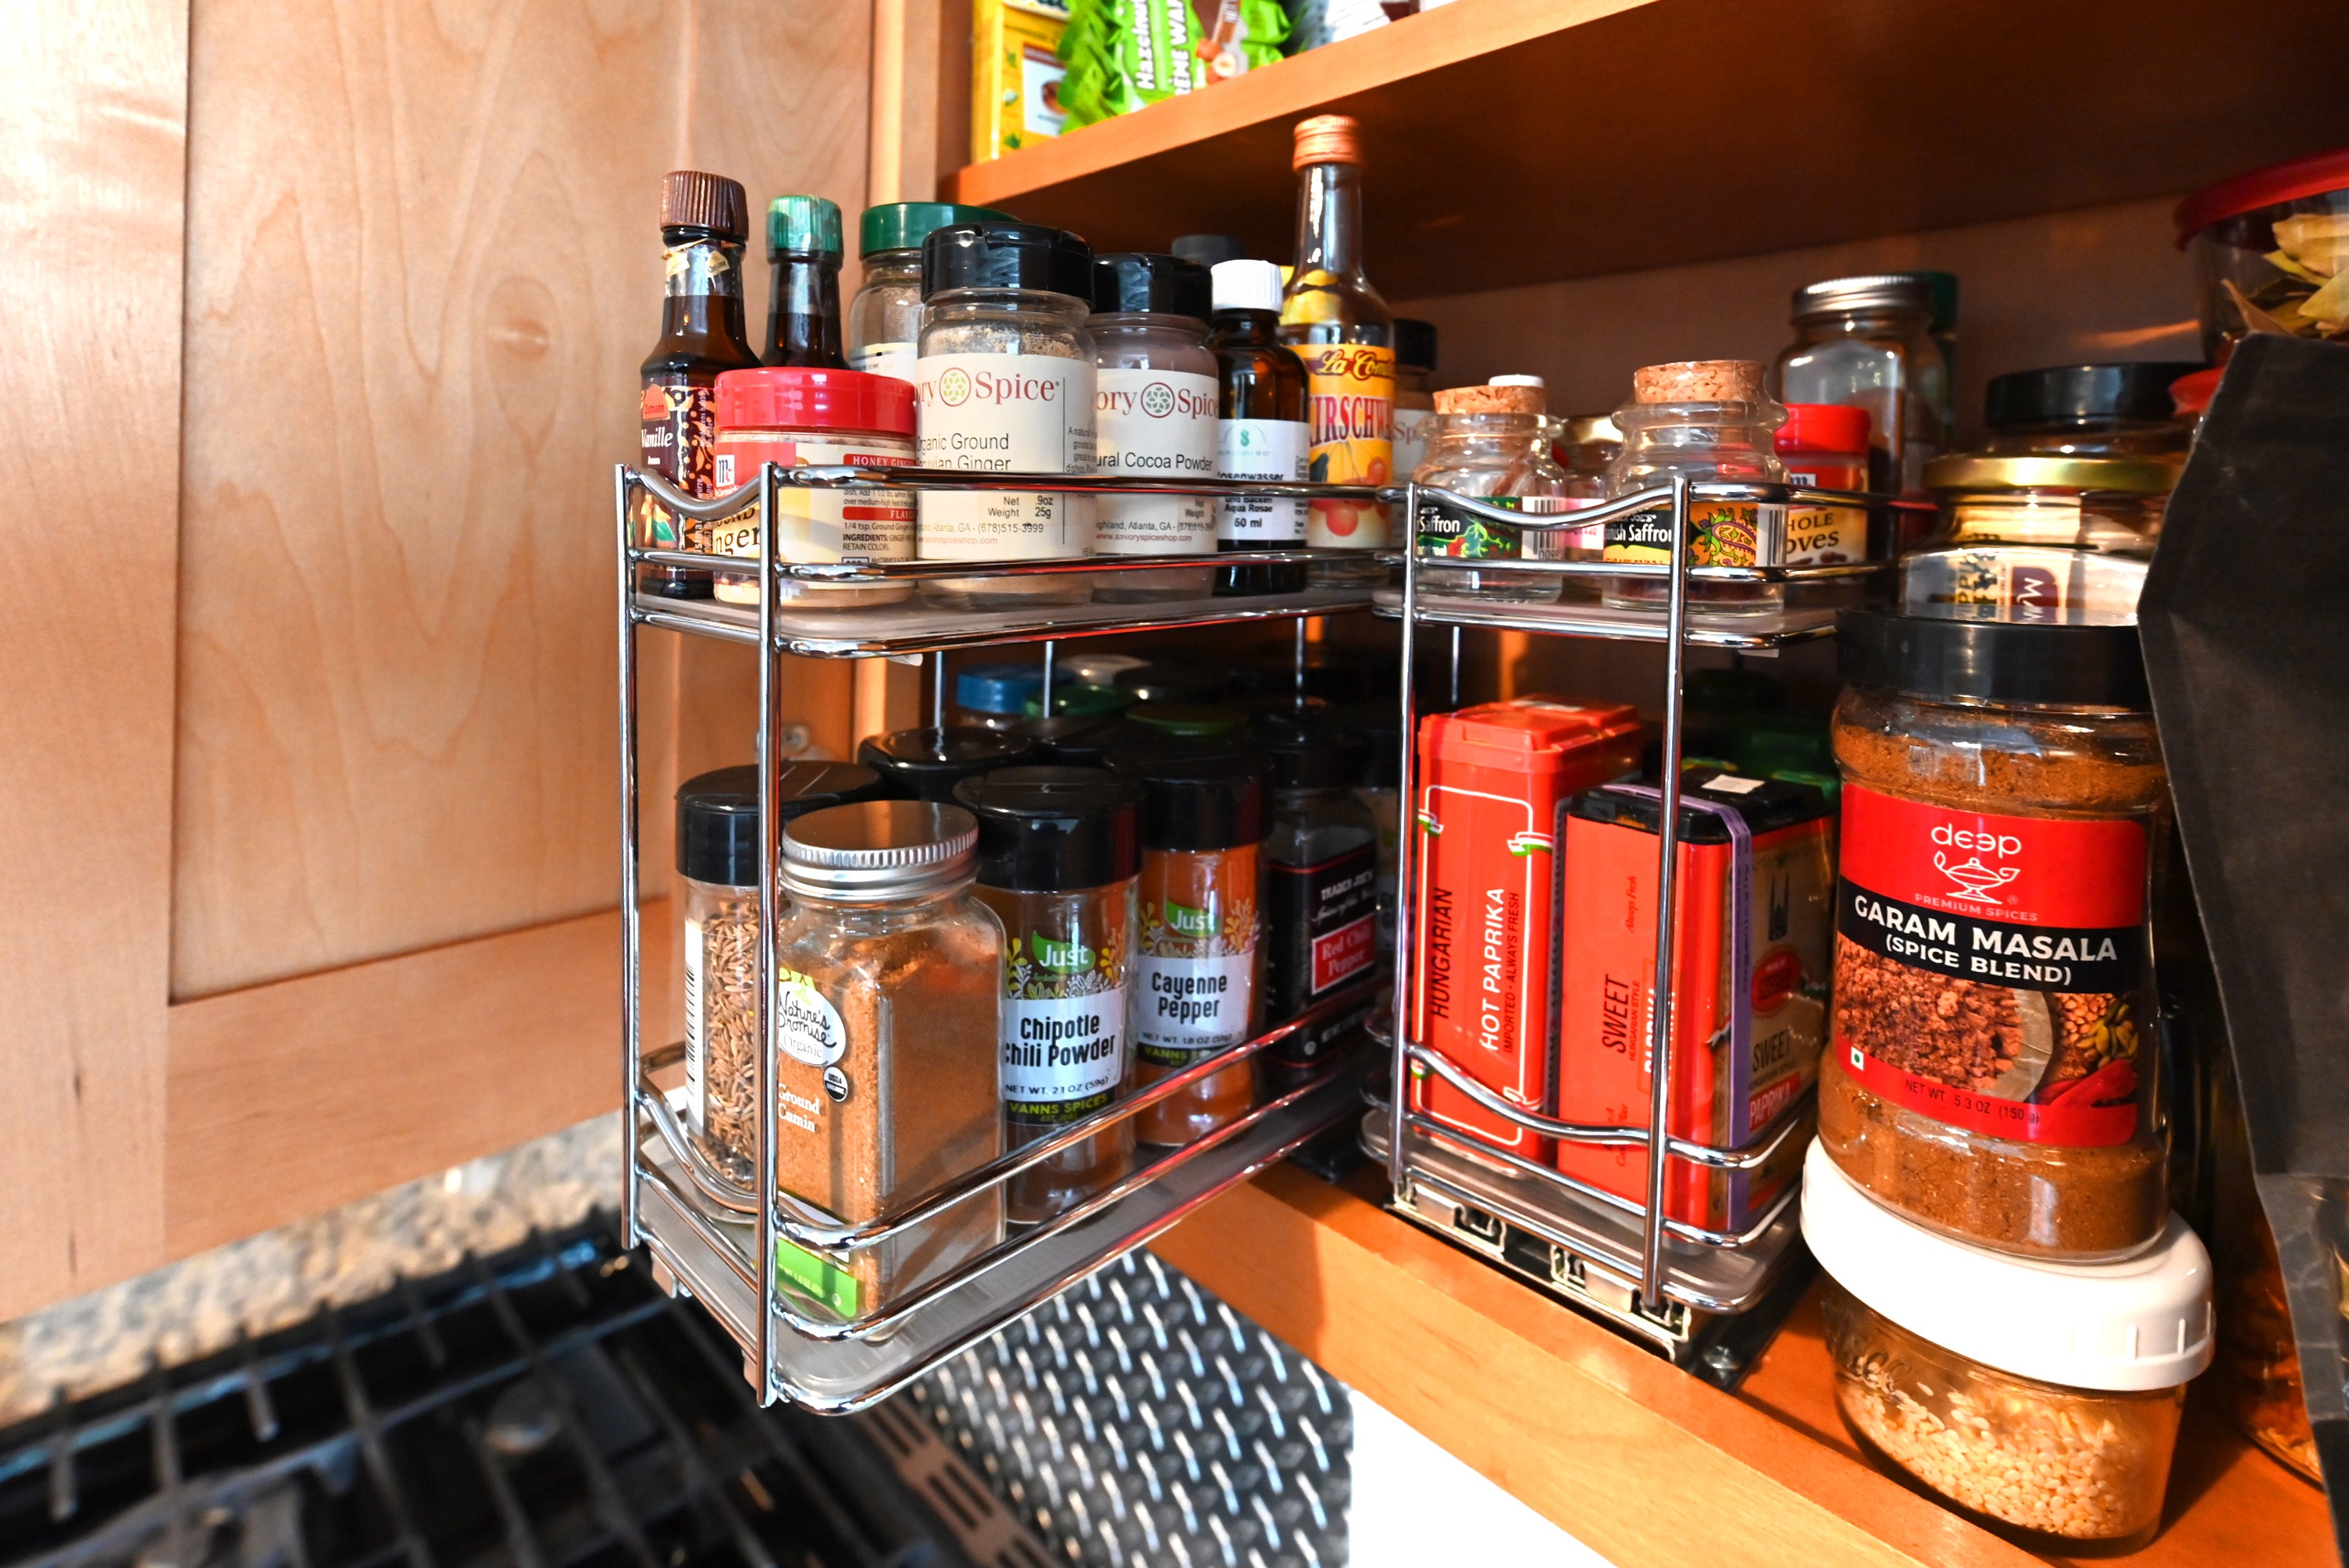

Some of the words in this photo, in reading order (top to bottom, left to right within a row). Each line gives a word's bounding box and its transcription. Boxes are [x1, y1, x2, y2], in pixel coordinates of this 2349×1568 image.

[975, 371, 1054, 404] Spice
[641, 426, 673, 448] Vanille
[951, 432, 1009, 451] Ground
[853, 456, 888, 467] HONEY
[957, 454, 1011, 470] Ginger
[1125, 452, 1171, 469] Cocoa
[1176, 454, 1213, 472] Powder
[988, 508, 1020, 519] Weight
[1035, 507, 1052, 519] 25g
[1003, 497, 1020, 506] Net
[1224, 503, 1246, 514] Aqua
[872, 522, 895, 531] Ground
[957, 522, 971, 533] GA
[1160, 522, 1171, 531] GA
[1234, 517, 1247, 528] 50
[1249, 518, 1263, 528] ml
[1419, 515, 1460, 533] Saffron
[843, 533, 889, 542] INGREDIENTS:
[843, 543, 866, 551] RETAIN
[1931, 823, 2022, 859] deep
[1626, 875, 1638, 900] Fresh
[1507, 891, 1520, 932] FRESH
[1624, 904, 1638, 935] Always
[1915, 893, 1982, 915] PREMIUM
[1986, 907, 2038, 922] SPICES
[1172, 910, 1215, 931] Just
[1855, 895, 1956, 946] GARAM
[1972, 927, 2118, 962] MASALA
[1323, 935, 1345, 960] Red
[1430, 886, 1453, 1019] HUNGARIAN
[1483, 888, 1505, 994] PAPRIKA
[1039, 944, 1089, 968] Just
[1328, 948, 1367, 976] Pepper
[1506, 935, 1518, 984] ALWAYS
[1885, 932, 1960, 968] (SPICE
[1970, 956, 2073, 986] BLEND)
[1152, 972, 1228, 1000] Cayenne
[1158, 996, 1221, 1025] Pepper
[1504, 992, 1517, 1054] IMPORTED
[1602, 973, 1630, 1054] SWEET
[1021, 1014, 1100, 1045] Chipotle
[1480, 996, 1501, 1052] HOT
[783, 1035, 822, 1058] Organic
[1048, 1035, 1115, 1067] Powder
[778, 1082, 820, 1115] Ground
[1006, 1084, 1025, 1093] NET
[1068, 1083, 1083, 1092] OZ
[1905, 1078, 1926, 1094] NET
[1976, 1099, 1991, 1115] OZ
[778, 1102, 816, 1134] Cumin
[1010, 1102, 1059, 1115] VANNS
